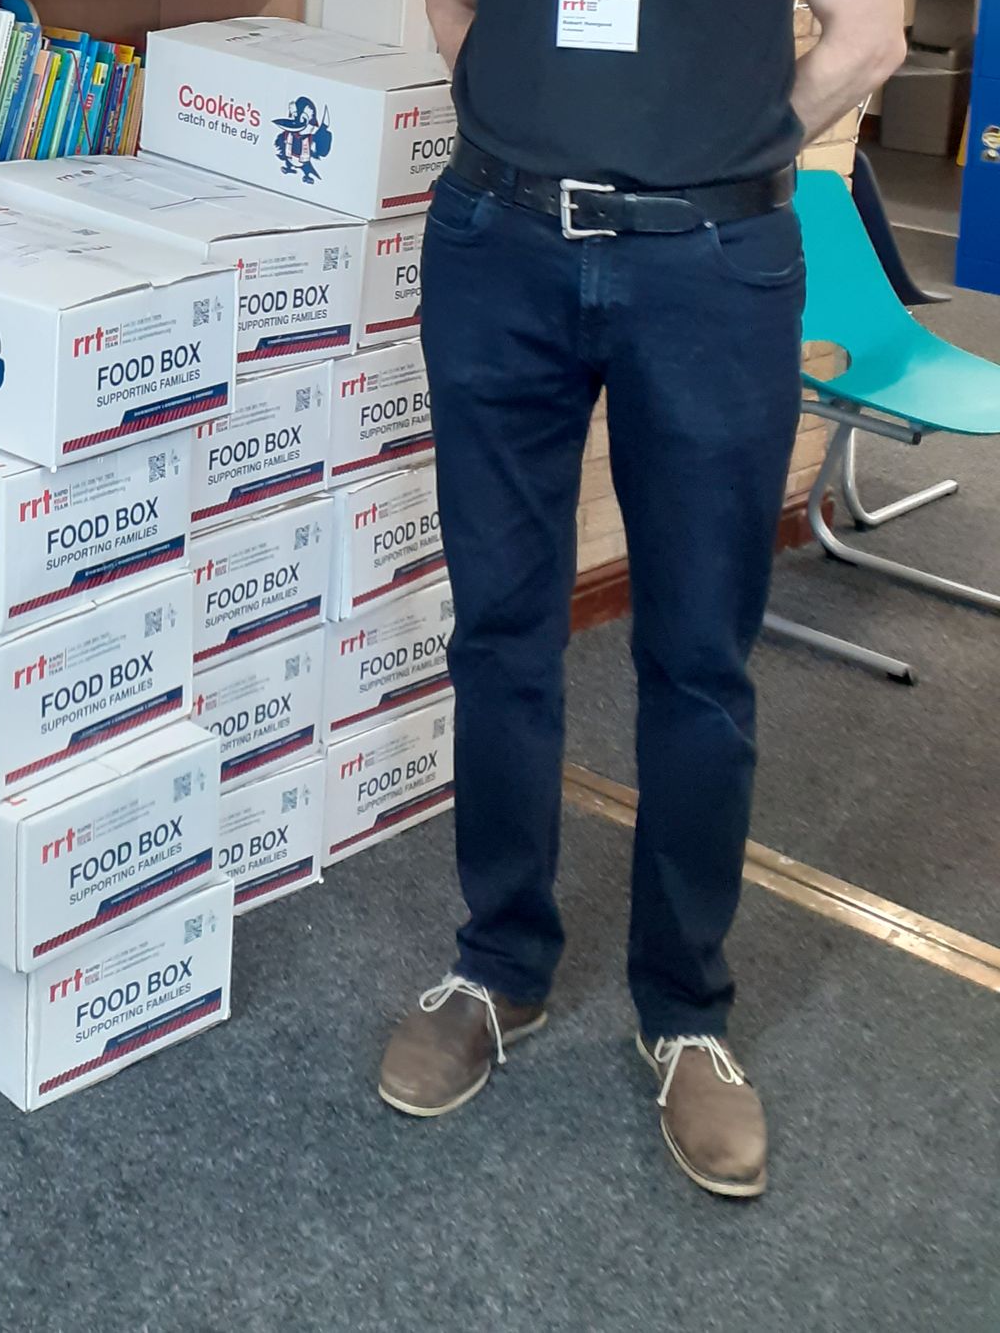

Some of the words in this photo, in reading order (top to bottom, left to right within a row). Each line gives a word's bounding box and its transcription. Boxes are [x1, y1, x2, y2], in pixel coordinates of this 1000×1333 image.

[178, 84, 261, 127] Cookie's
[394, 106, 420, 130] rrt
[177, 110, 206, 128] catch
[208, 119, 220, 132] of
[221, 122, 238, 138] the
[240, 127, 260, 145] day
[377, 232, 402, 256] rrt
[394, 287, 422, 300] SUPPO
[395, 264, 418, 286] FO
[239, 291, 287, 317] FOOD
[293, 284, 330, 308] BOX
[291, 309, 328, 325] FAMILIES
[73, 326, 104, 358] rrt
[97, 354, 155, 391] FOOD
[161, 340, 202, 374] BOX
[341, 372, 366, 398] rrt
[96, 381, 158, 408] SUPPORTING
[160, 368, 201, 389] FAMILIES
[361, 396, 408, 426] FOOD
[413, 390, 432, 412] BO
[208, 438, 259, 470] FOOD
[264, 424, 302, 449] BOX
[207, 459, 262, 486] SUPPORTING
[263, 450, 300, 471] FAMILIES
[19, 489, 52, 522] rrt
[47, 515, 109, 554] FOOD
[116, 496, 159, 532] BOX
[355, 502, 378, 530] rrt
[46, 540, 112, 571] SUPPORTING
[114, 525, 158, 549] FAMILIES
[373, 521, 416, 554] FOOD
[420, 511, 440, 536] BO
[194, 559, 214, 585] rt
[206, 578, 258, 614] FOOD
[263, 562, 301, 593] BOX
[205, 600, 260, 629] SUPPORTING
[261, 586, 298, 608] FAMILIES
[340, 629, 367, 657] rrt
[360, 647, 408, 681] FOOD
[412, 632, 449, 660] BOX
[13, 655, 47, 690] rrt
[41, 674, 103, 718] FOOD
[110, 651, 154, 689] BOX
[41, 698, 107, 735] SUPPORTING
[109, 678, 153, 705] FAMILIES
[205, 711, 249, 737] OOD
[254, 692, 292, 725] BOX
[340, 752, 366, 780] rrt
[358, 767, 402, 802] FOOD
[406, 750, 438, 780] BOX
[41, 827, 75, 865] rrt
[70, 841, 132, 889] FOOD
[139, 815, 183, 856] BOX
[218, 842, 244, 869] OD
[250, 825, 289, 857] BOX
[69, 867, 136, 906] SUPPORTING
[138, 843, 183, 872] FAMILIES
[49, 968, 83, 1004] rrt
[76, 981, 141, 1028] FOOD
[148, 956, 193, 995] BOX
[75, 1005, 144, 1043] SUPPORTING
[146, 983, 192, 1012] FAMILIES
